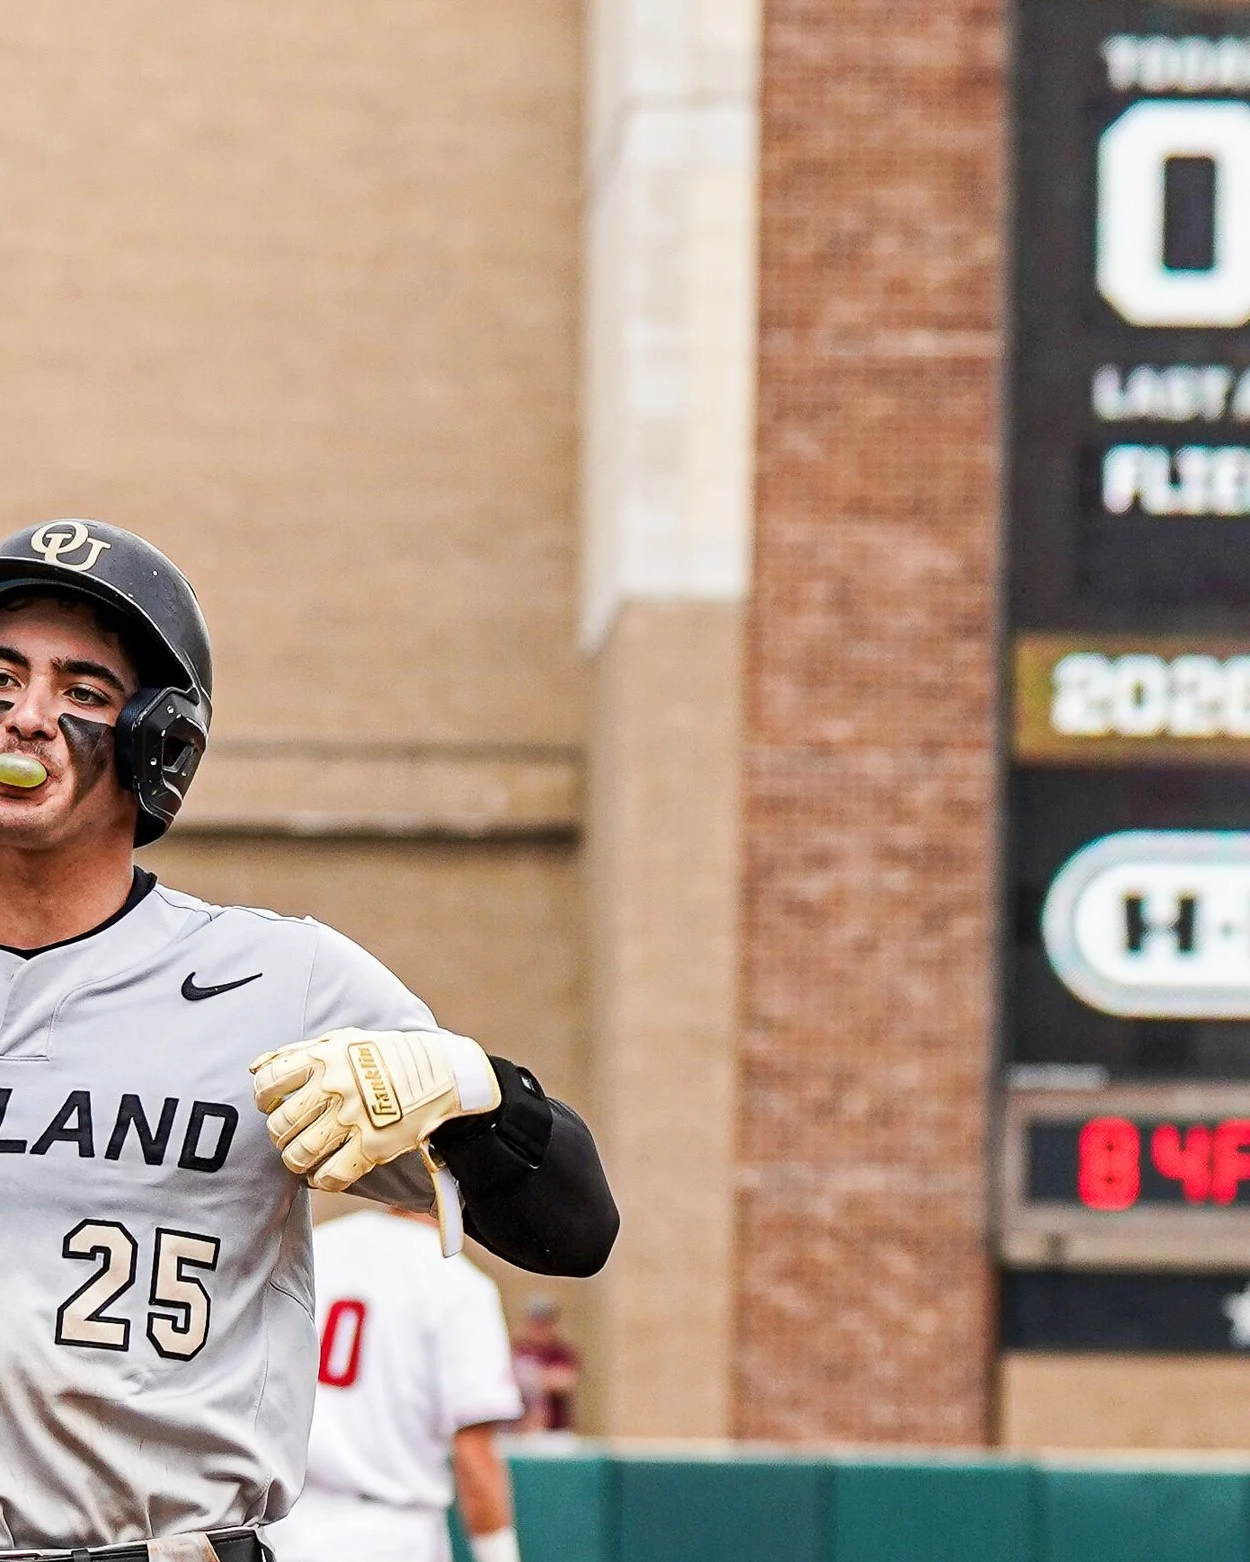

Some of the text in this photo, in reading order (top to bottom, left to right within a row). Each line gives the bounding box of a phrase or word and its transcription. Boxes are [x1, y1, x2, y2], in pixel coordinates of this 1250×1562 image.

[357, 1046, 397, 1116] Franklin
[54, 1217, 221, 1363] 25
[317, 1297, 367, 1389] 0
